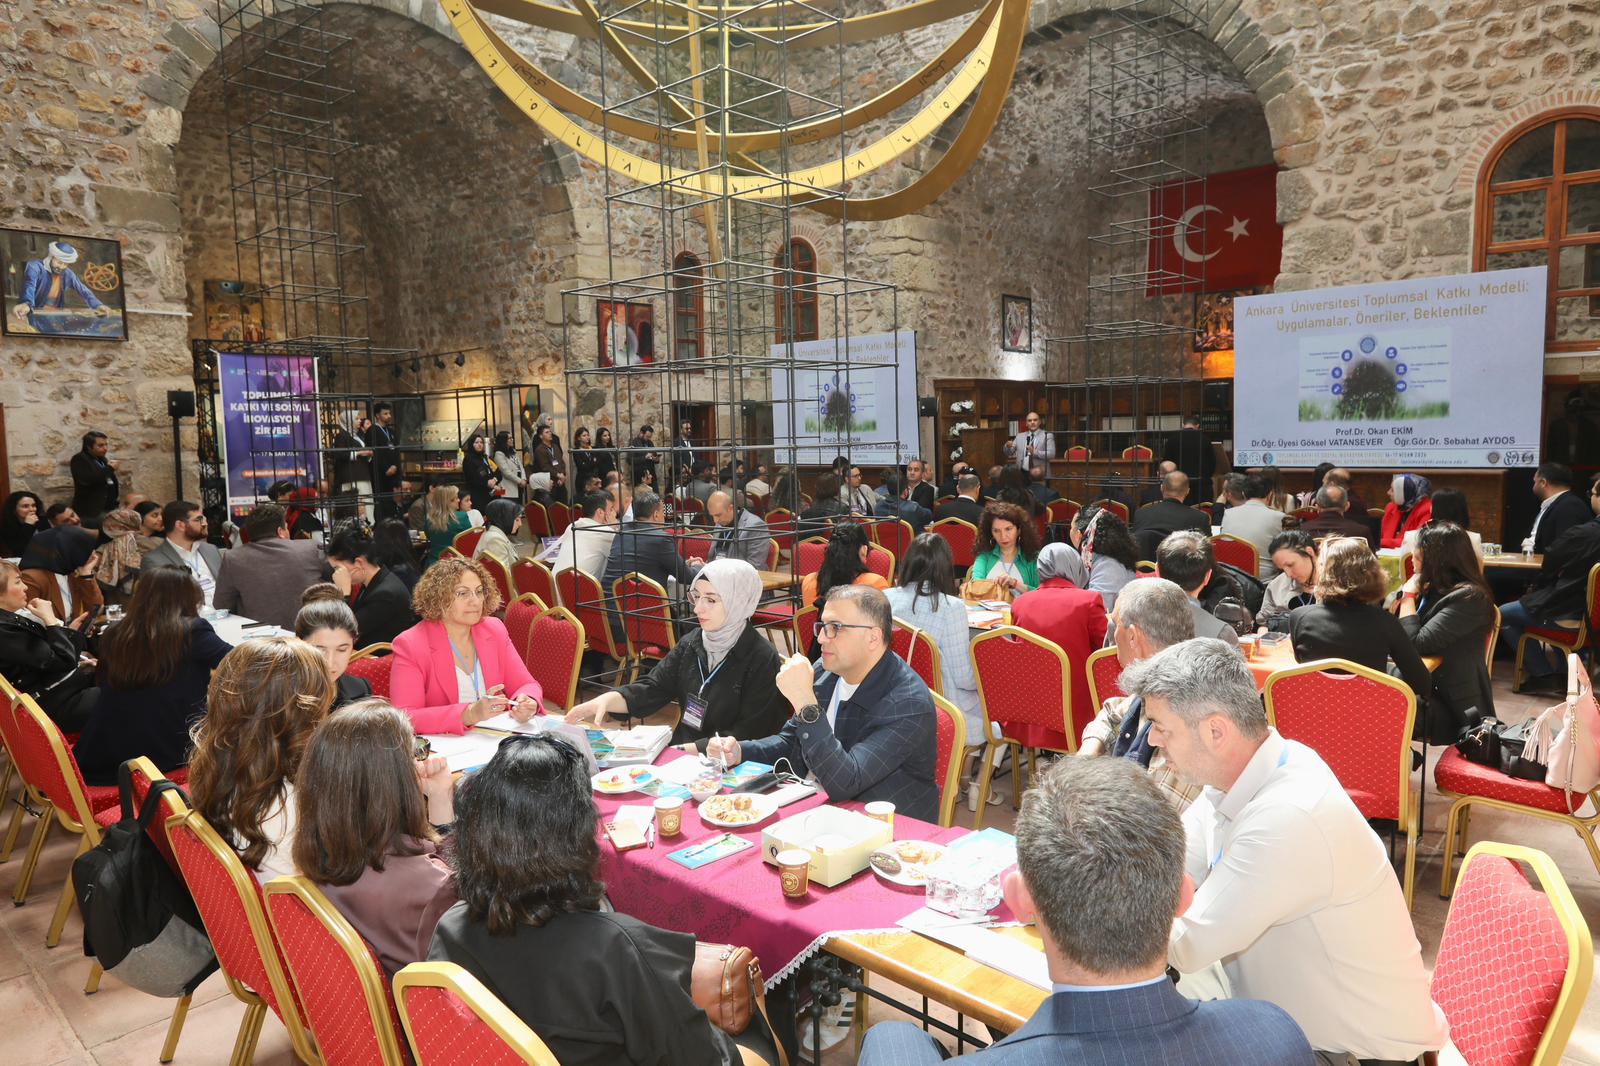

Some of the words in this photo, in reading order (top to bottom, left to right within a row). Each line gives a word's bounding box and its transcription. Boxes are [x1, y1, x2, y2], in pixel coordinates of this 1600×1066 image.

[1246, 304, 1284, 318] Ankara
[1363, 289, 1428, 307] Toplumsal
[1480, 280, 1529, 296] Modeli:
[1277, 315, 1351, 333] Uygulamalar,
[1356, 310, 1410, 325] Öneriler,
[1335, 428, 1365, 436] Prof.Dr.
[1391, 427, 1413, 435] EKİM
[1278, 439, 1299, 448] Üyesi
[1300, 439, 1327, 447] Göksel
[1329, 438, 1383, 446] VATANSEVER
[1443, 437, 1479, 445] Sebahat
[1482, 436, 1516, 445] AYDOS
